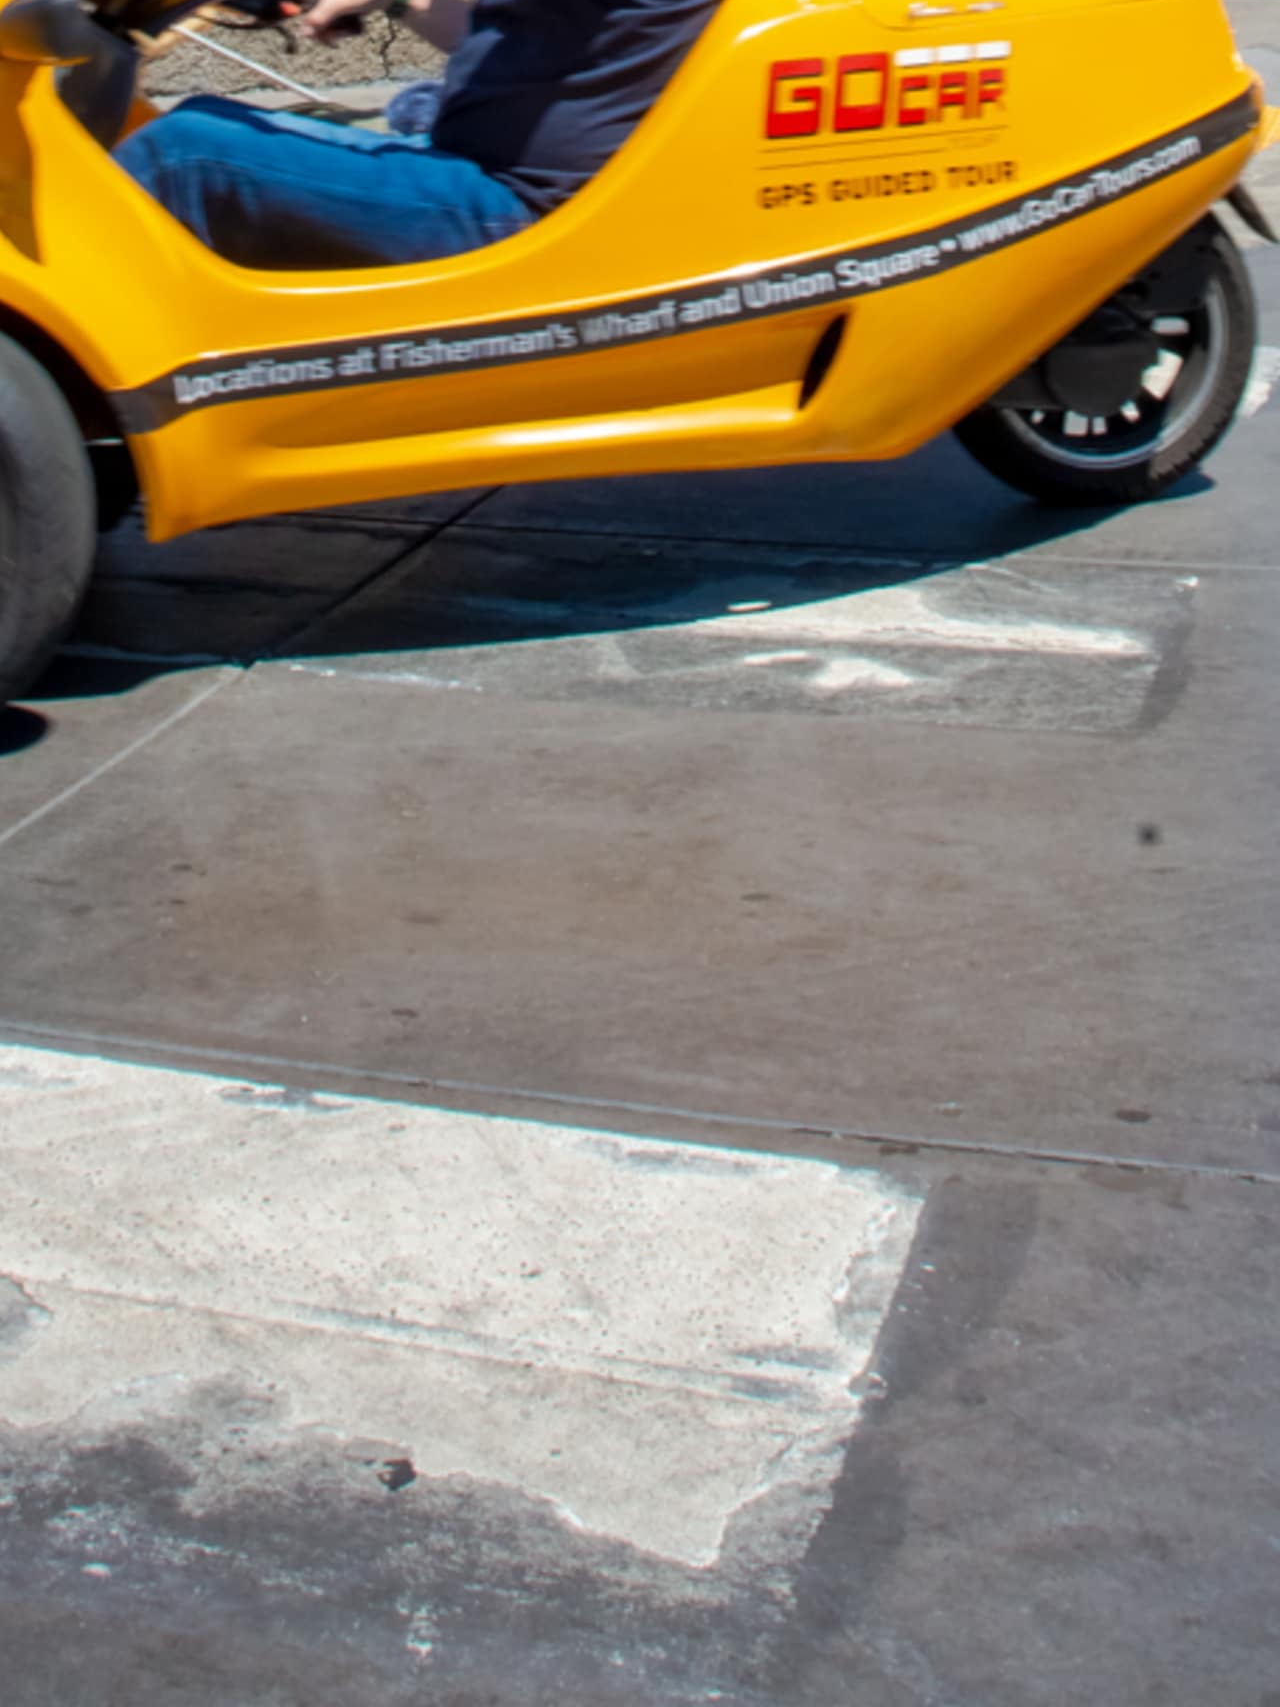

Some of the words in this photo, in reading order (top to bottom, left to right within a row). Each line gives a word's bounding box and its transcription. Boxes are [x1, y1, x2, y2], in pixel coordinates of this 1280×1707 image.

[757, 182, 817, 210] GPS
[828, 169, 938, 202] GUIDED
[946, 160, 1018, 189] TOUR
[173, 353, 335, 405] Locations
[337, 348, 377, 377] at
[379, 322, 578, 372] Fisherman's
[577, 297, 678, 346] Wharf
[679, 288, 740, 321] and
[739, 268, 836, 310] Union
[835, 239, 939, 290] Square
[956, 134, 1201, 252] www.GoCarTours.com
